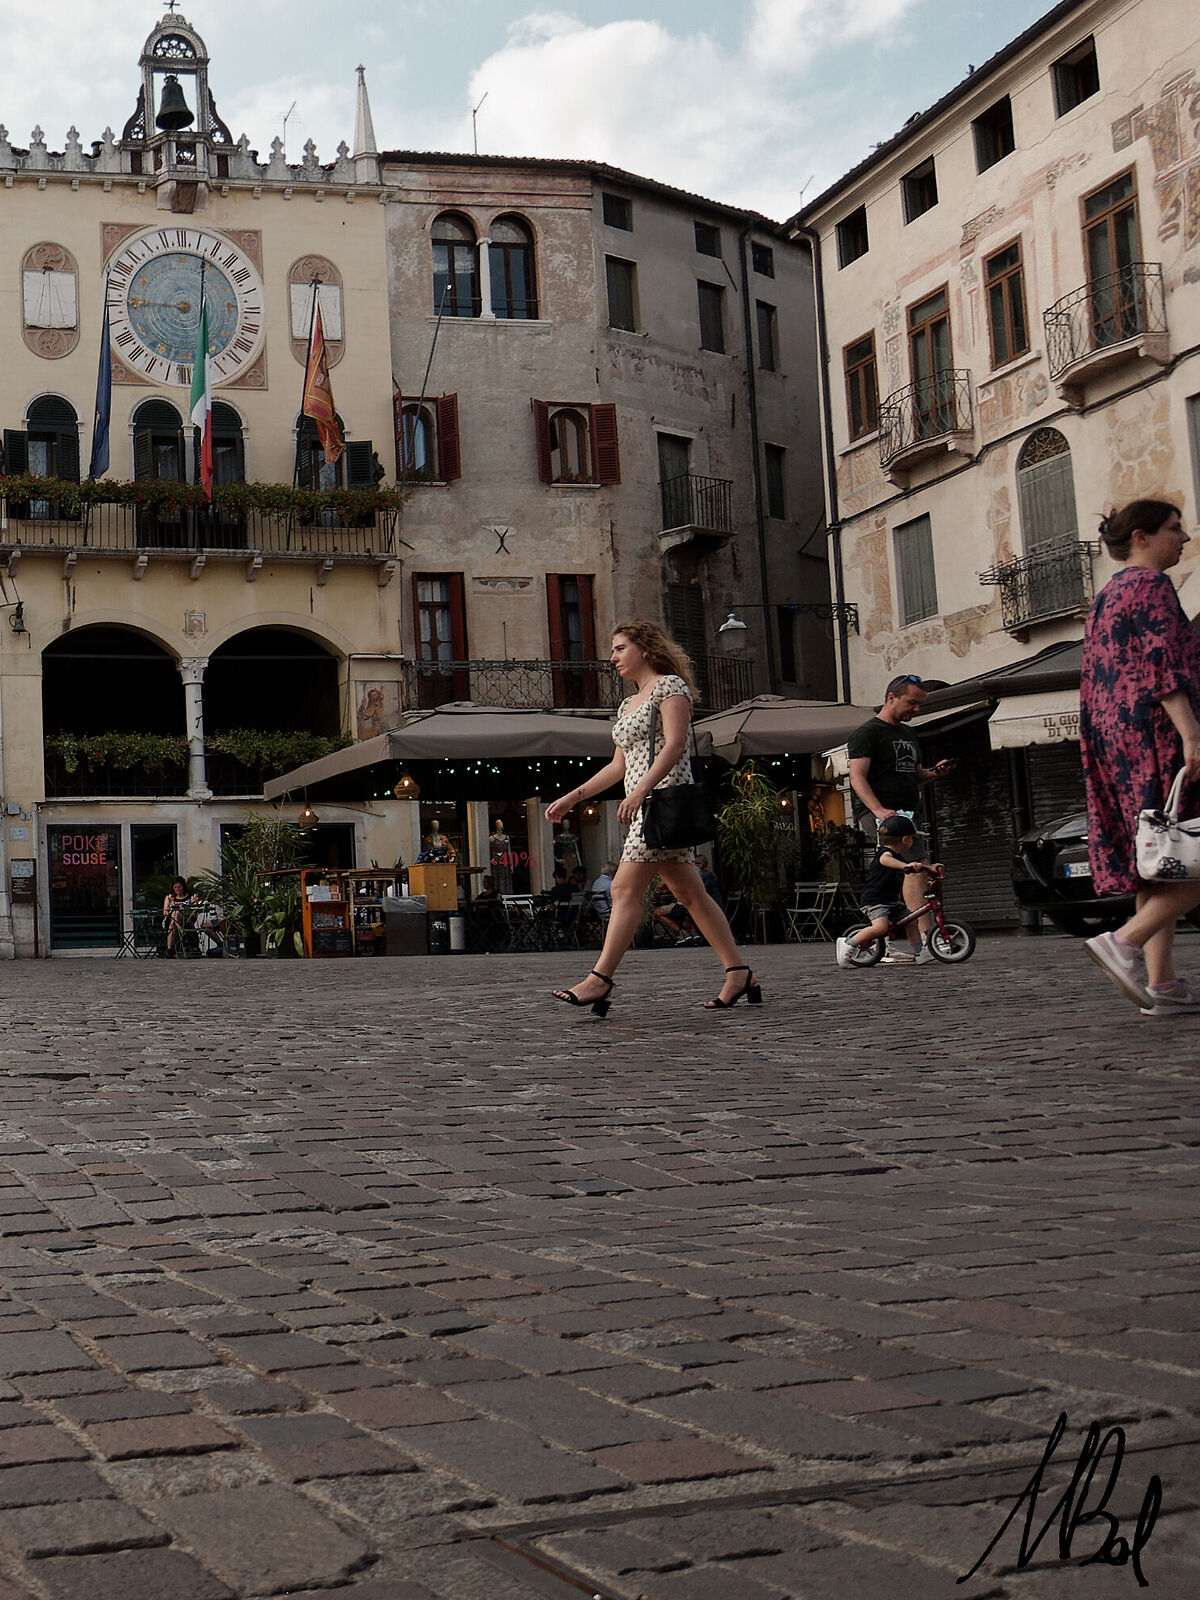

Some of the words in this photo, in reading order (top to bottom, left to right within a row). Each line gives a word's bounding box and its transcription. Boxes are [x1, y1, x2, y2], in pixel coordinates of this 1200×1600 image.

[1043, 717, 1056, 728] IL
[1059, 713, 1080, 726] GIO
[1048, 727, 1061, 737] DI
[1065, 725, 1080, 735] VI
[62, 835, 107, 851] POKE
[63, 852, 108, 865] SCUSE
